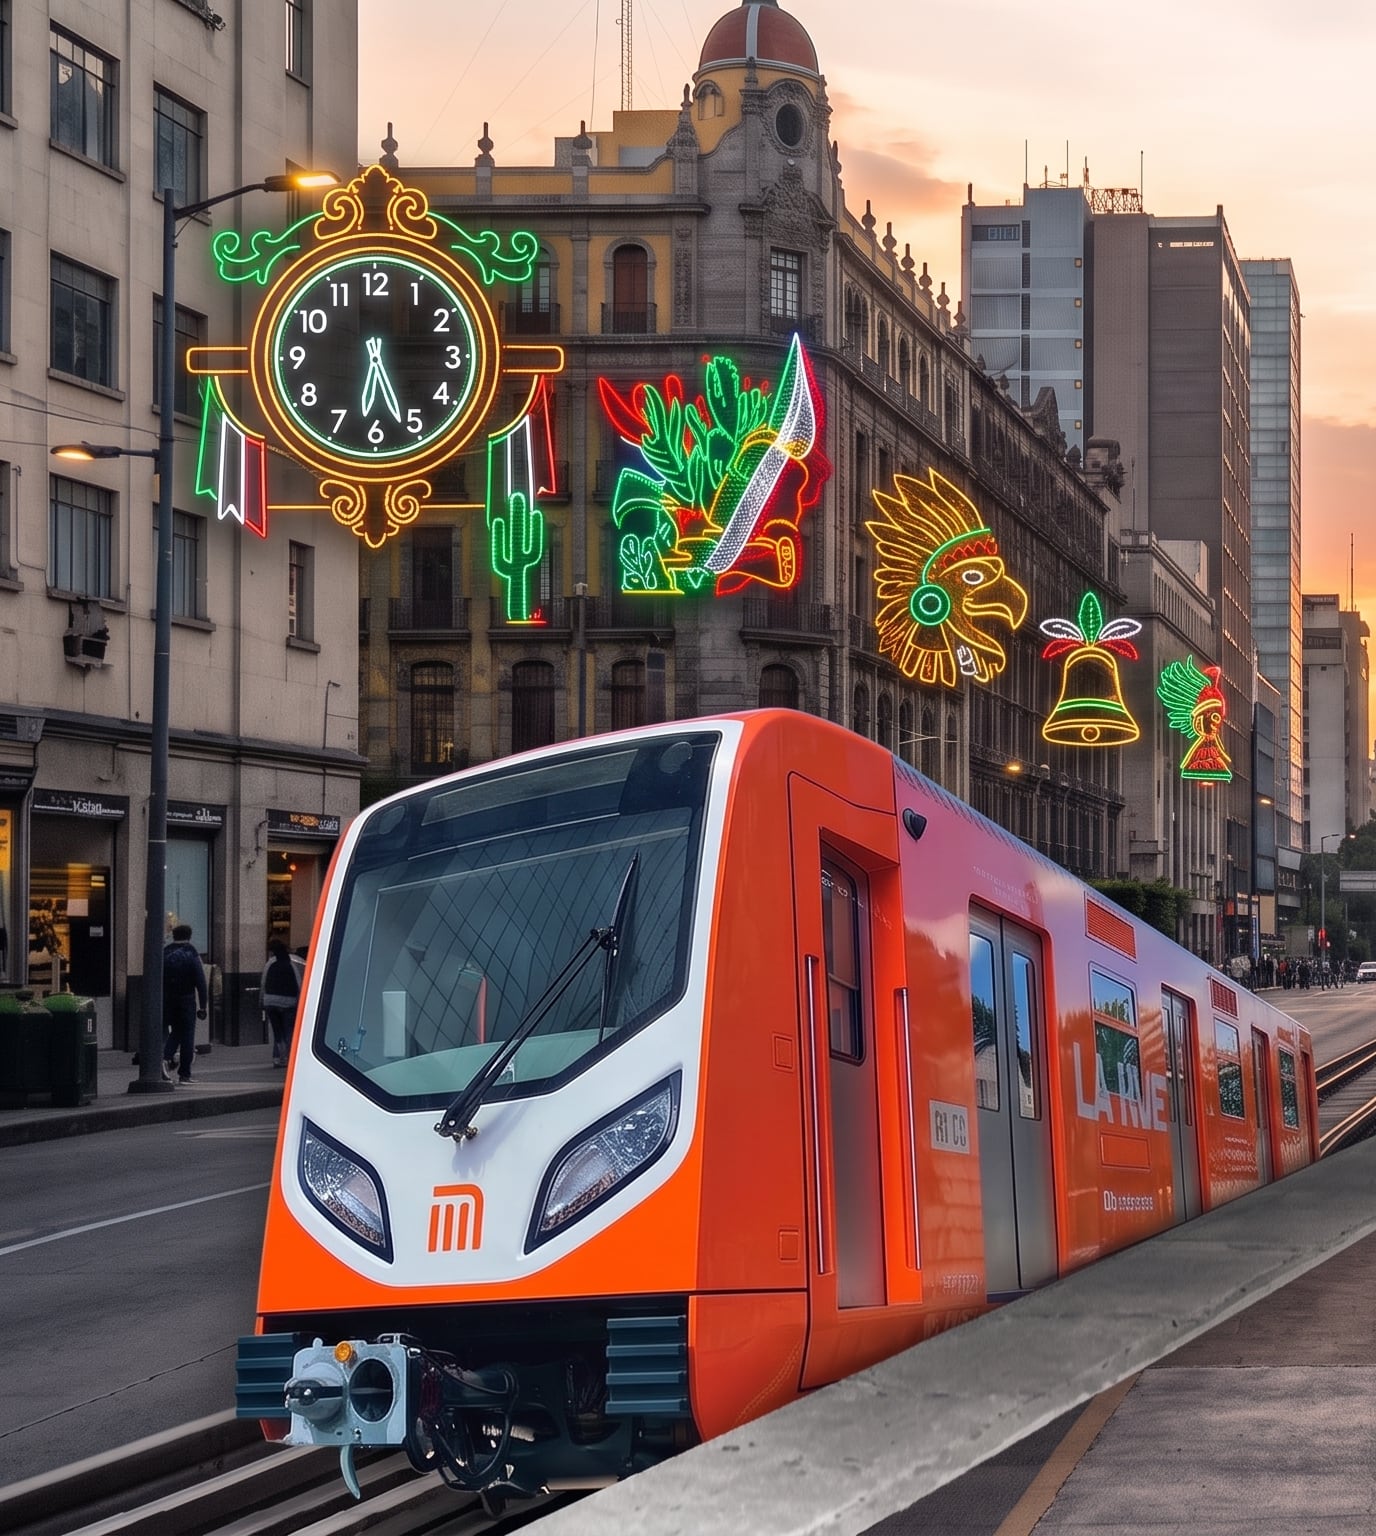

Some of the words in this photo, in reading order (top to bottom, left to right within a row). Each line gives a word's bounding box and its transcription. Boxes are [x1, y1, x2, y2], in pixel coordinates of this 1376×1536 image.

[330, 283, 349, 307] 11
[362, 272, 389, 296] 12
[410, 282, 419, 306] 1
[299, 309, 328, 334] 10
[433, 308, 450, 333] 2
[289, 346, 306, 370] 9
[444, 345, 461, 369] 3
[300, 382, 318, 407] 8
[432, 381, 450, 406] 4
[330, 409, 348, 434] 7
[367, 419, 384, 444] 6
[406, 409, 423, 433] 5
